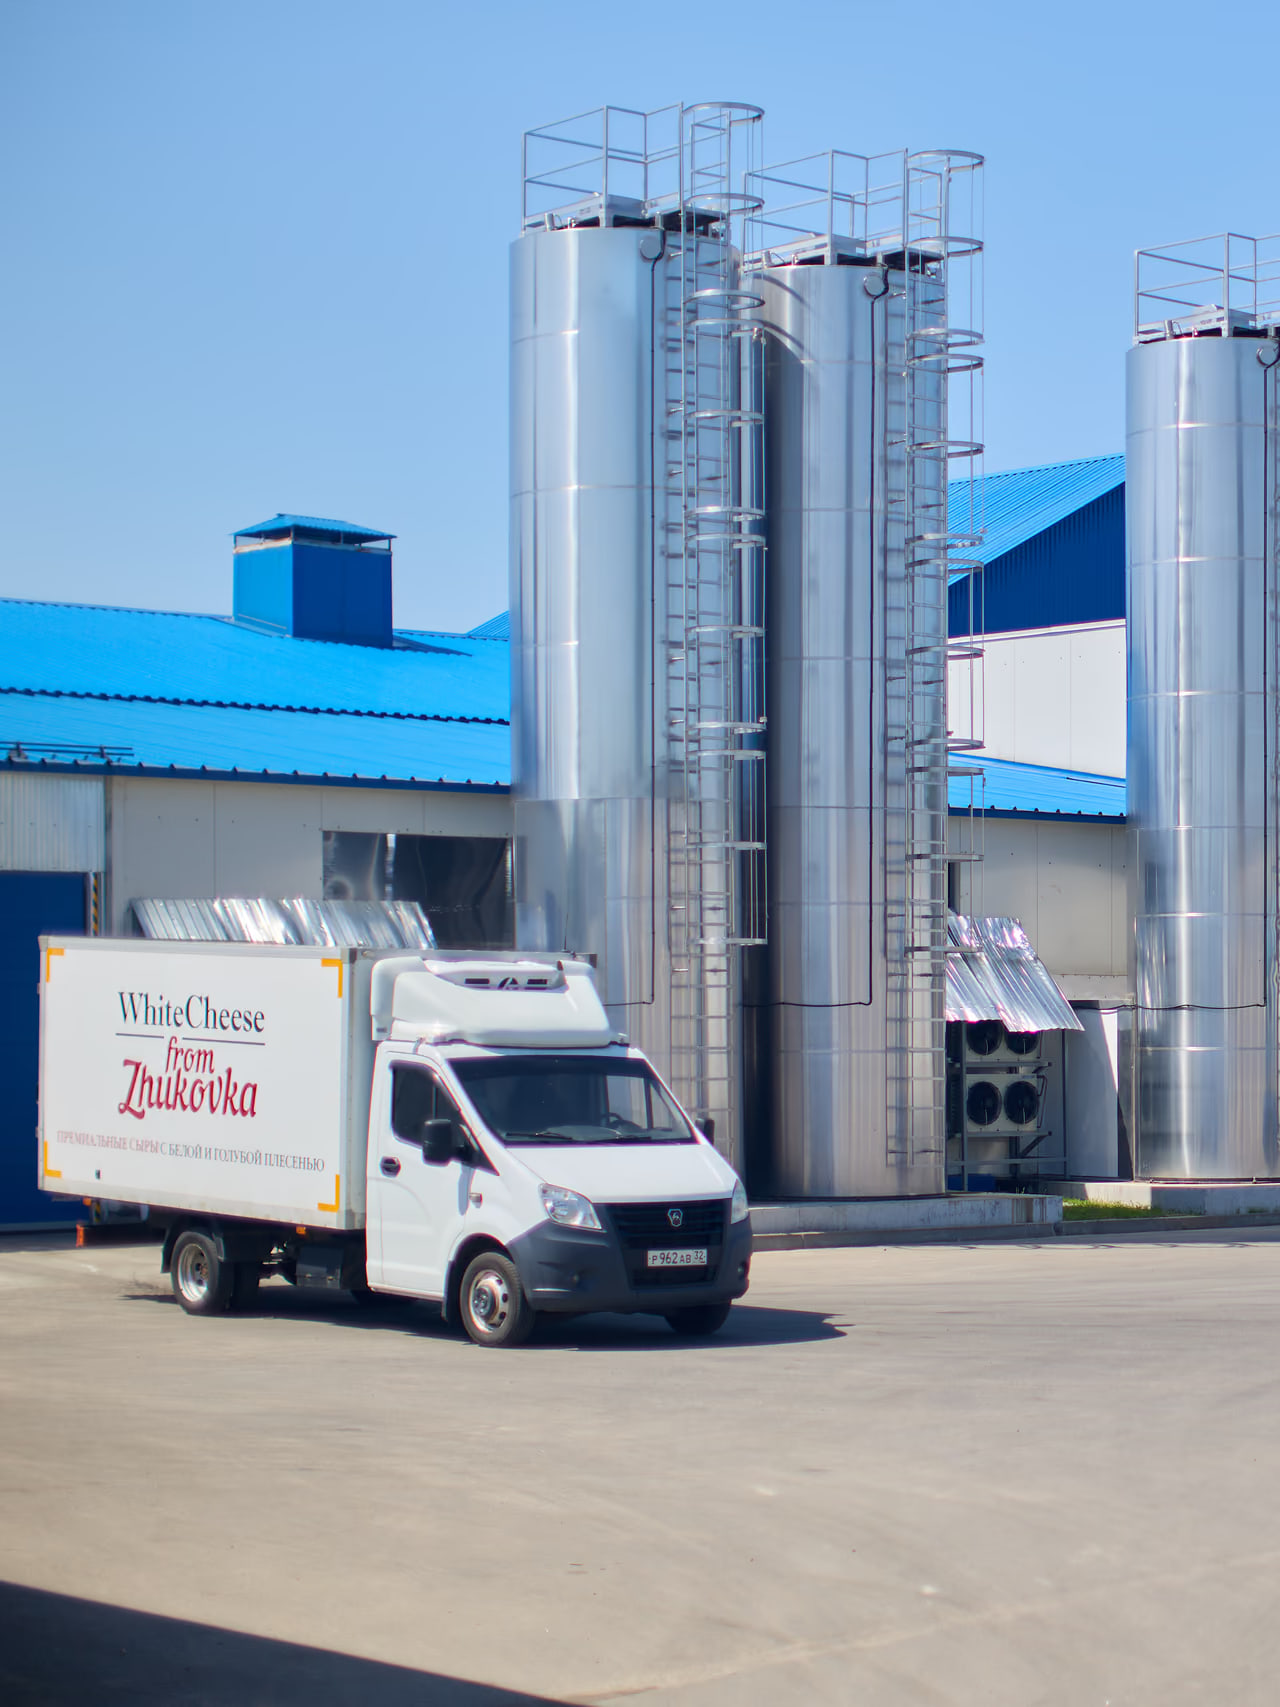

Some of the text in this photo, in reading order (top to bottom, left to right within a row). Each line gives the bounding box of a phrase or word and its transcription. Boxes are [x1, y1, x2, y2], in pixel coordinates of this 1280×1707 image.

[165, 1035, 214, 1074] from
[118, 1059, 257, 1120] Zhukovka
[56, 1130, 128, 1150] ПРЕМИАЛЬНЫЕ
[129, 1138, 160, 1153] СЫРЫ
[169, 1142, 202, 1159] БЕЛОЙ
[204, 1146, 212, 1160] И
[214, 1147, 262, 1166] ГОЛУБОЙ
[264, 1152, 325, 1172] ПЛЕСЕНЬЮ
